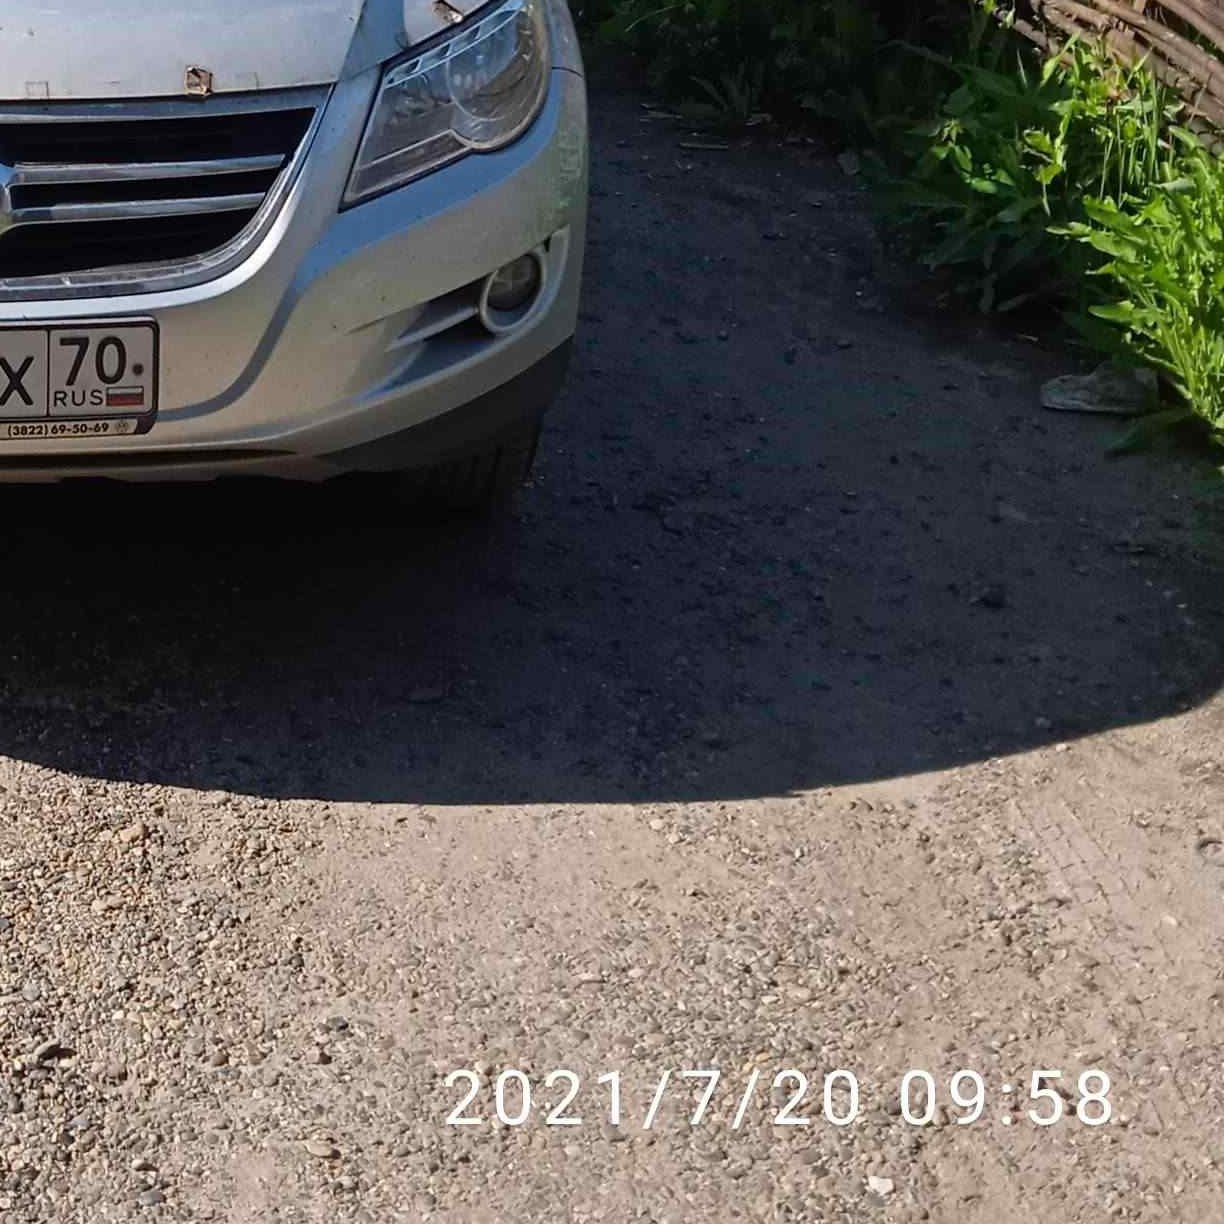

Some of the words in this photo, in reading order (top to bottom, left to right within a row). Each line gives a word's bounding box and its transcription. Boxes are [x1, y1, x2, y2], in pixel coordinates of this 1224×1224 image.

[59, 336, 128, 386] 70
[53, 389, 105, 408] RUS
[7, 424, 49, 437] (3822)
[50, 422, 110, 435] 69-50-69
